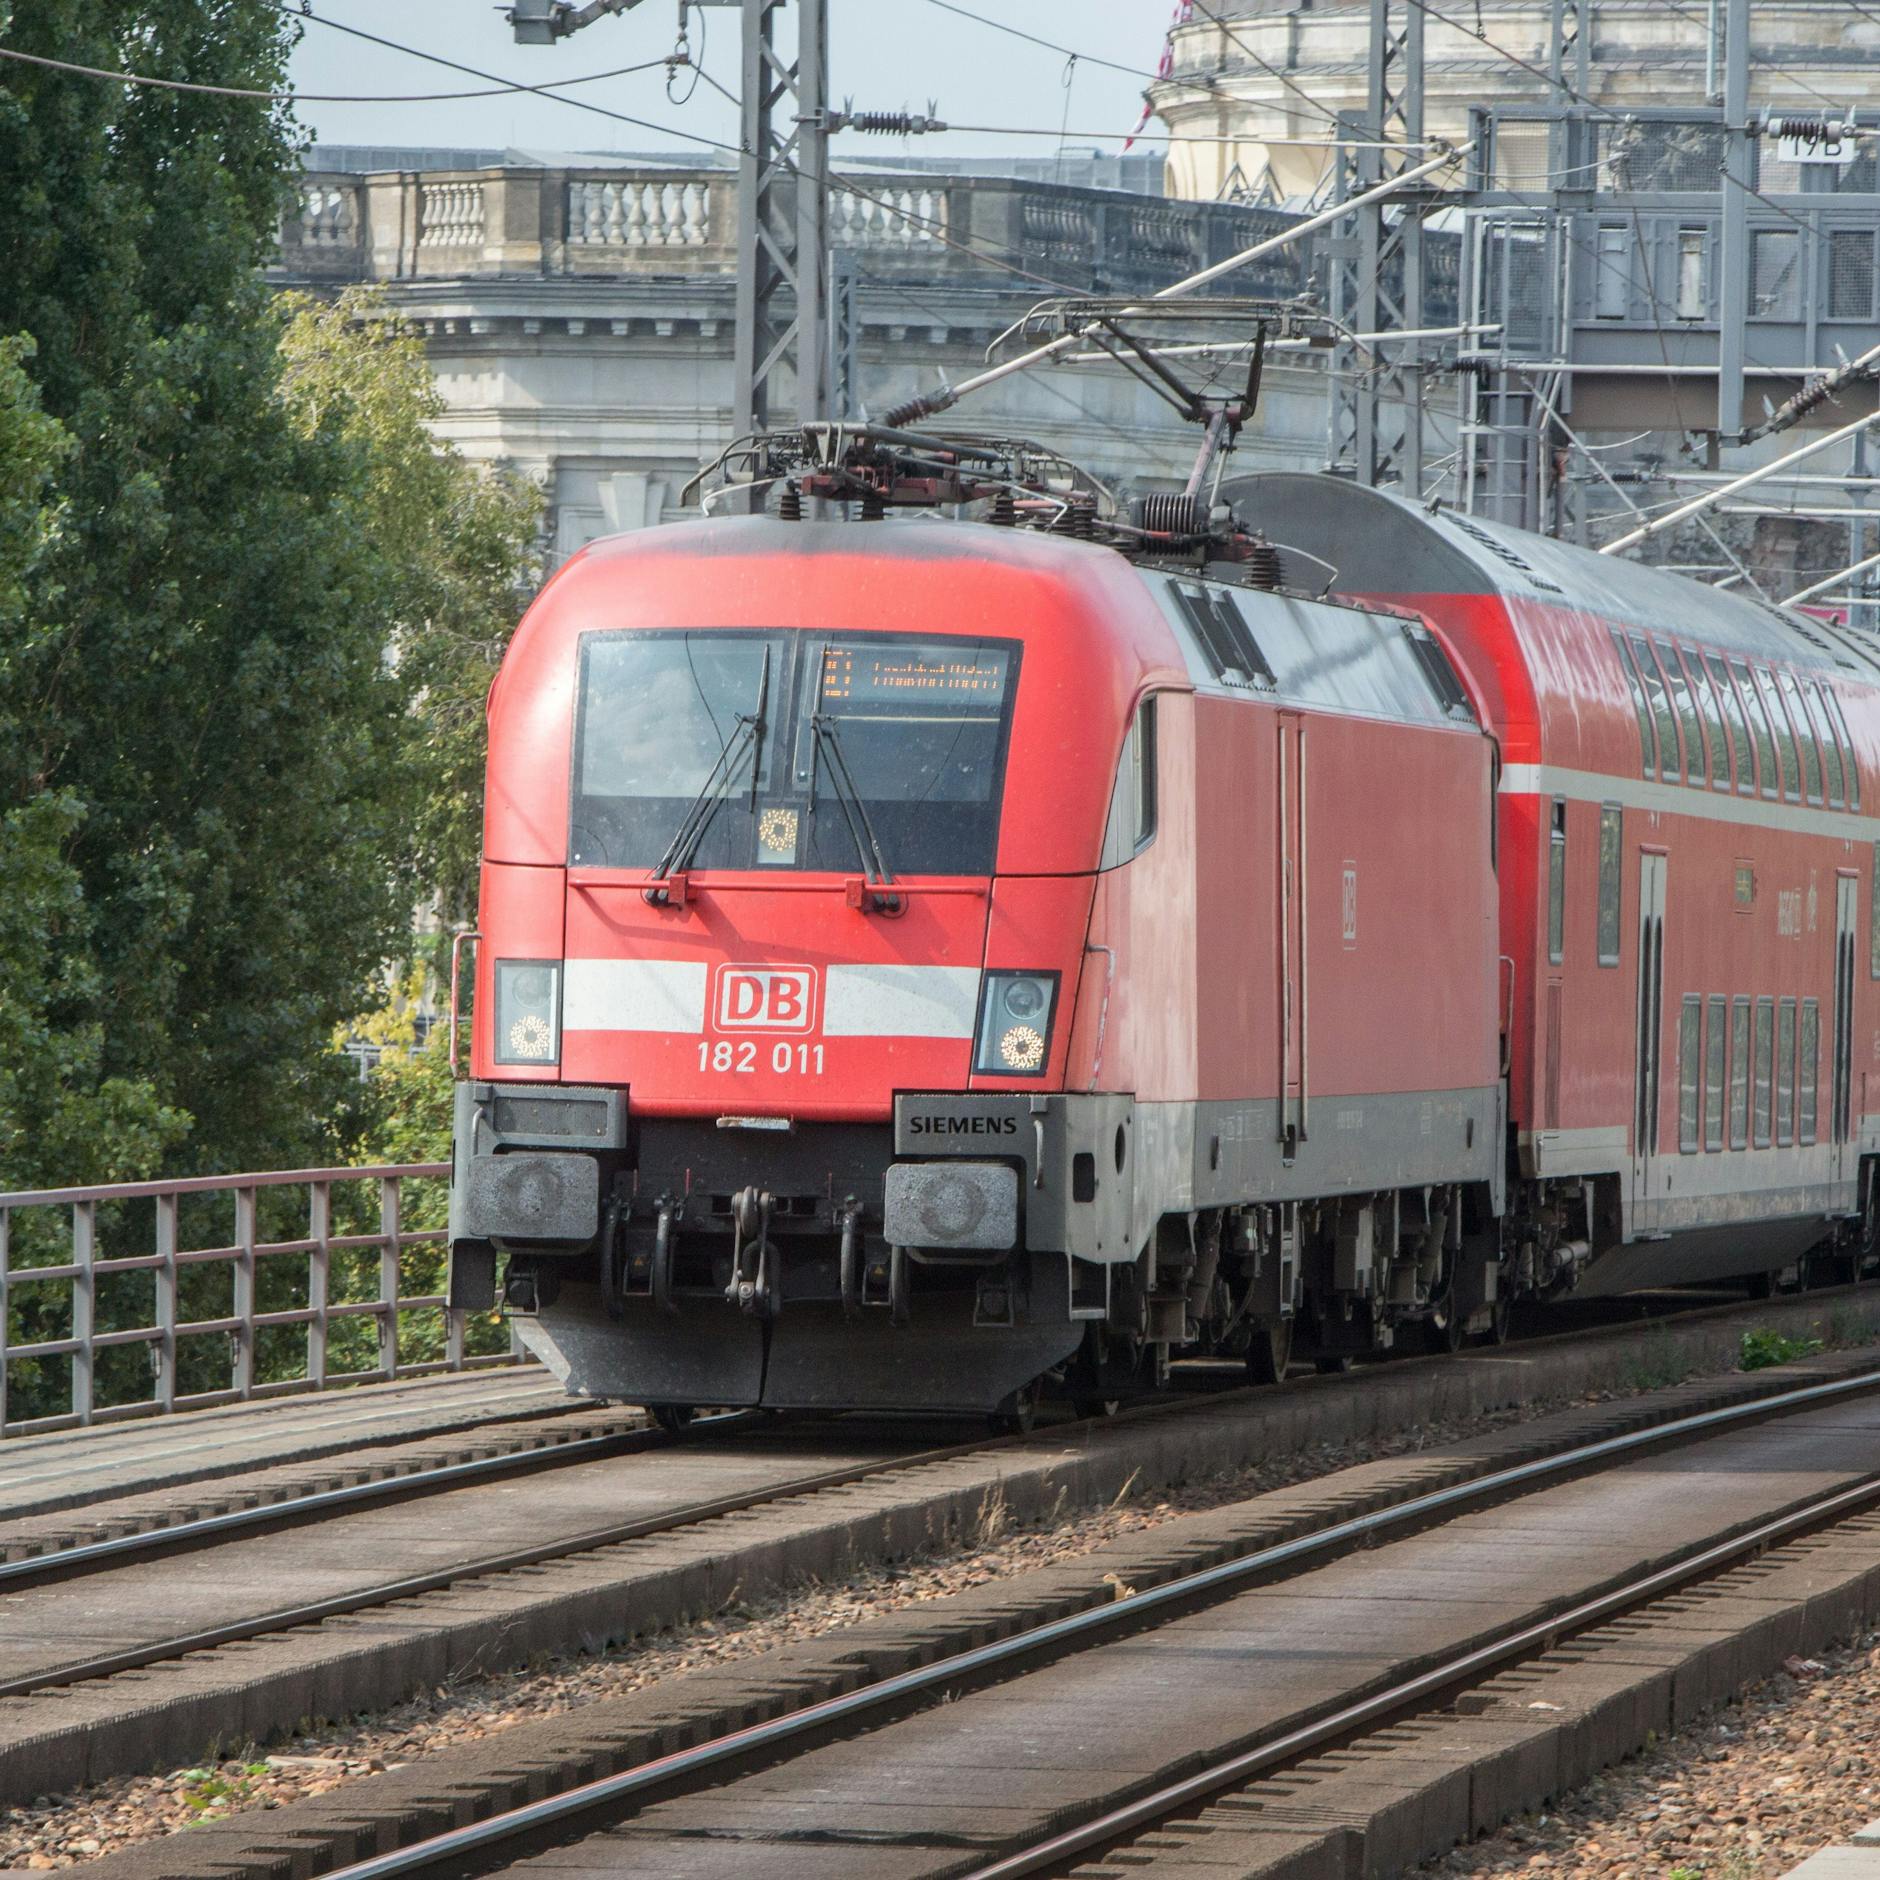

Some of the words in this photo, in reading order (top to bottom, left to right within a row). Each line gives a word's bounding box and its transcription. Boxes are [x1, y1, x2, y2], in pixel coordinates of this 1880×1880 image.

[728, 975, 802, 1021] DB
[697, 1041, 757, 1073] 182
[772, 1042, 824, 1075] 011
[910, 1116, 1017, 1135] SIEMENS
